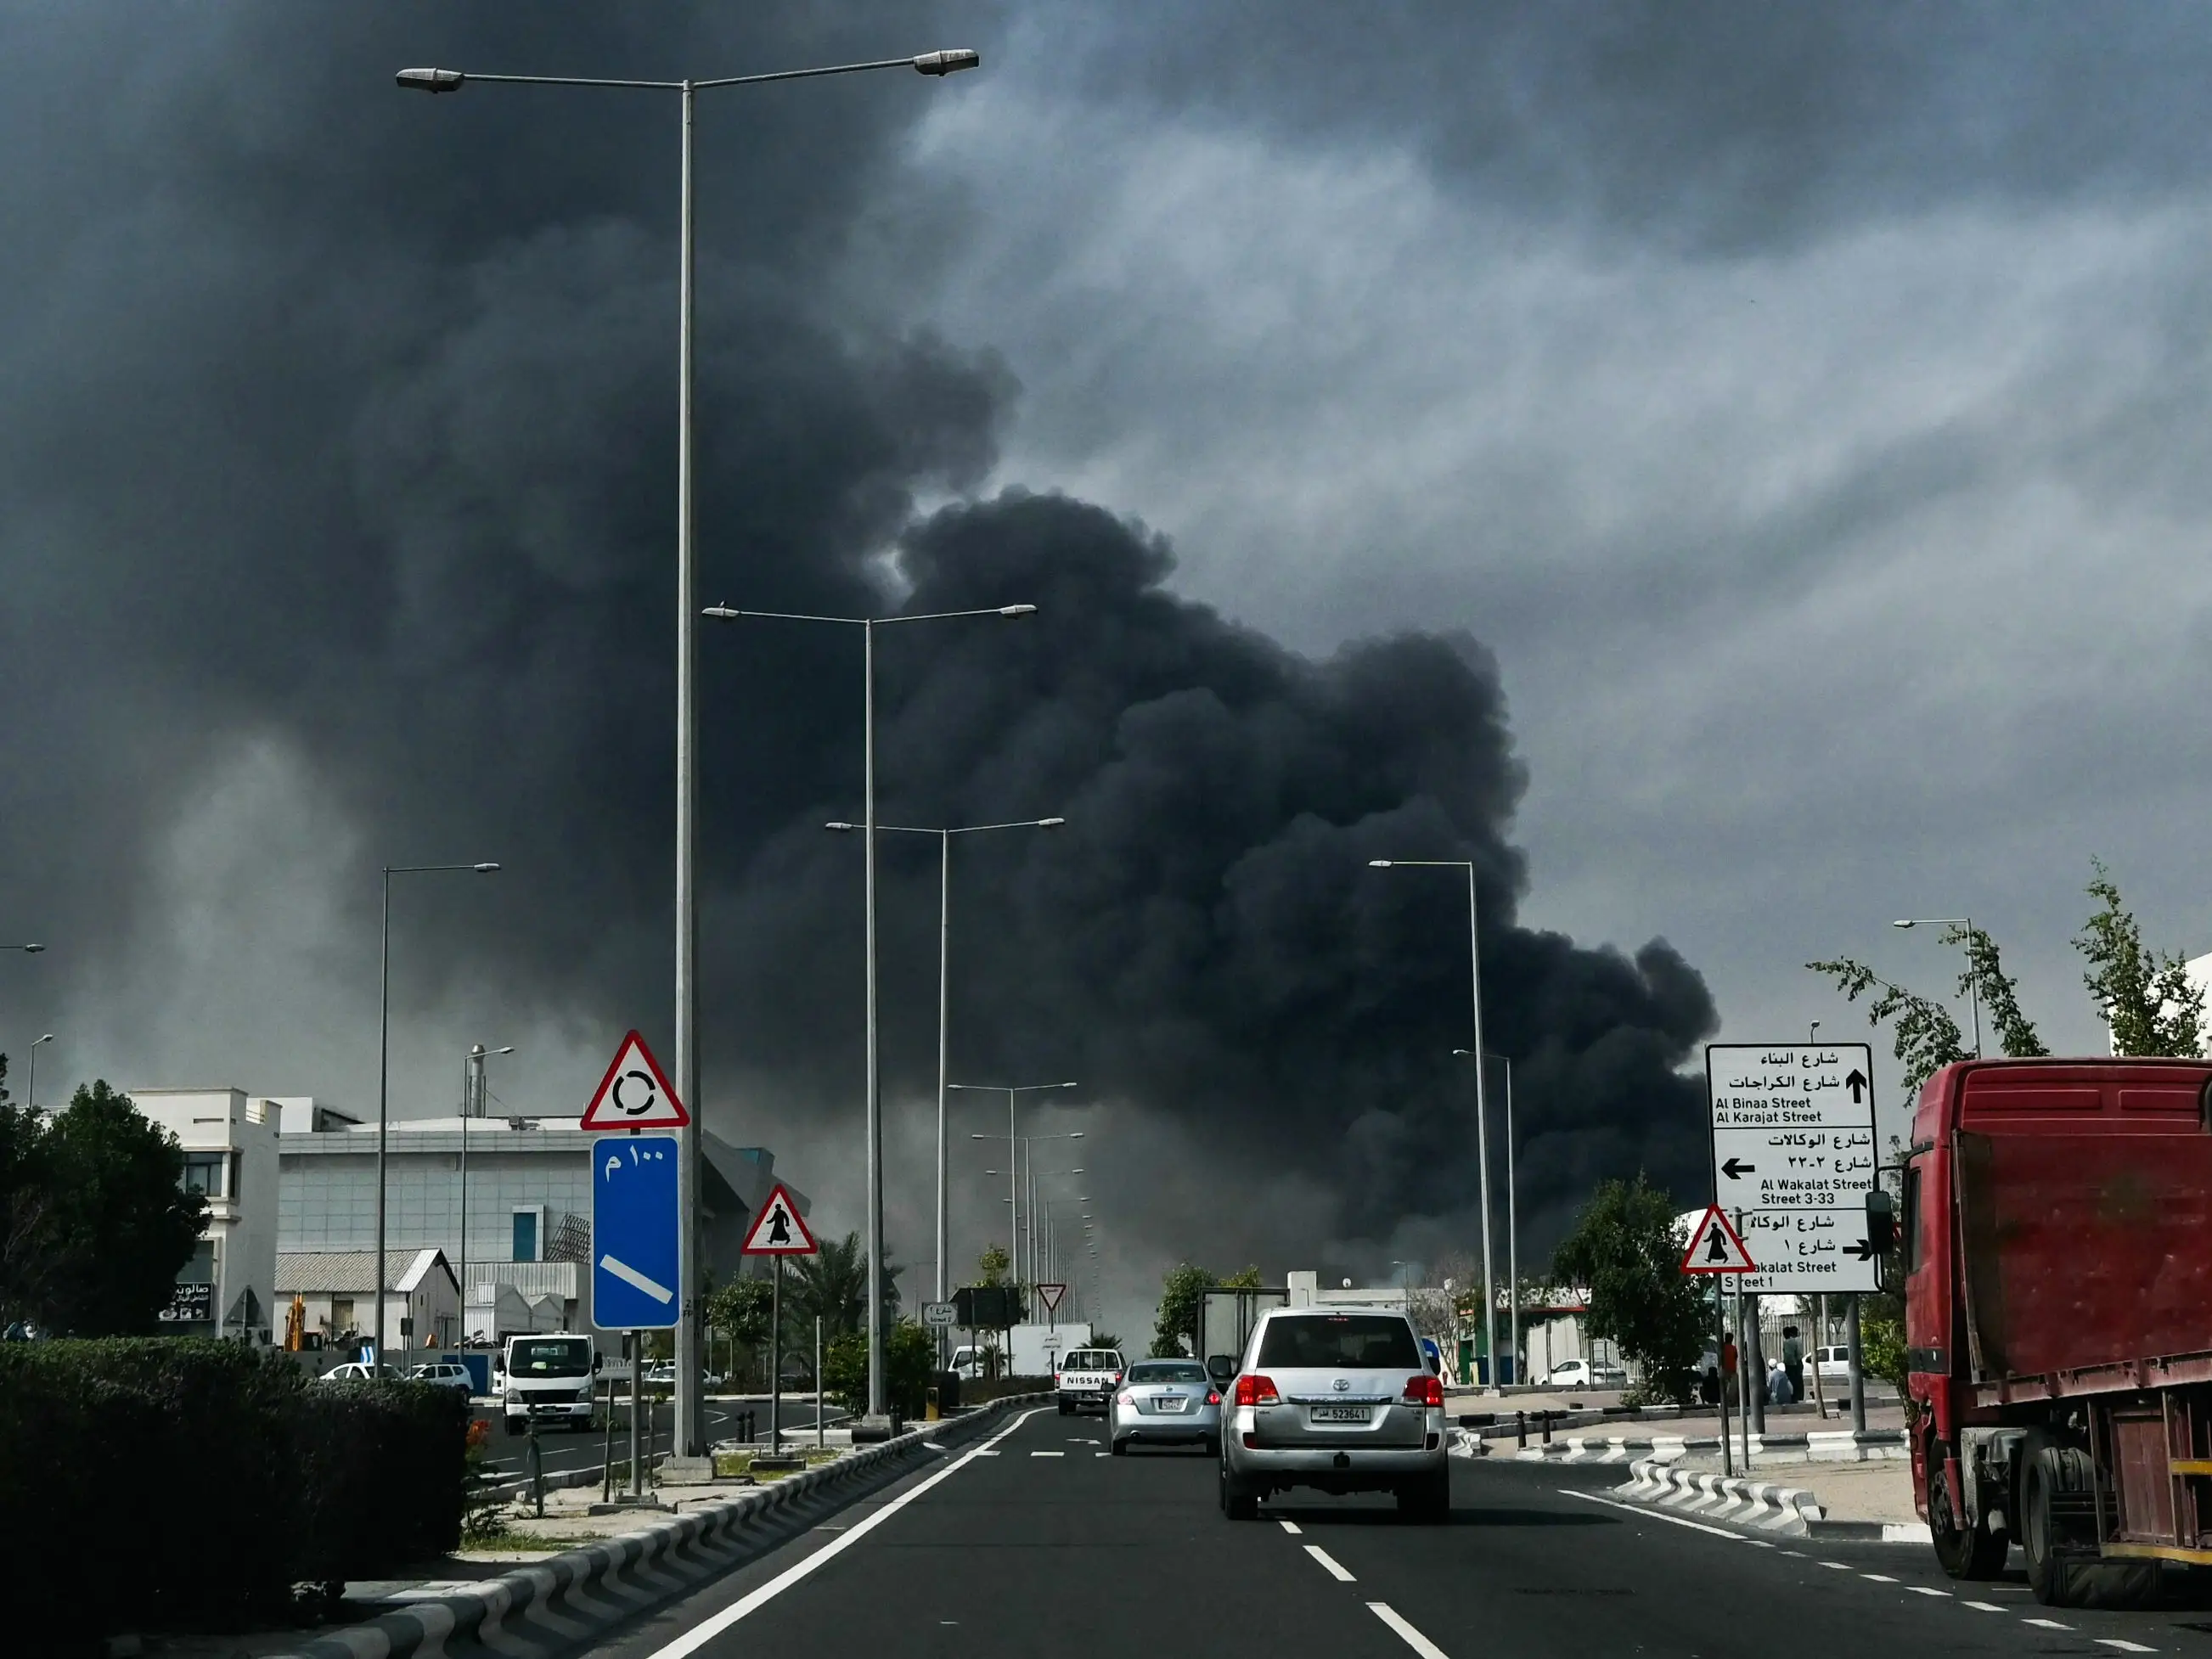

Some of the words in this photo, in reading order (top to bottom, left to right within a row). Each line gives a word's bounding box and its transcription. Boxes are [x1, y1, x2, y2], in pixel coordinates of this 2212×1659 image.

[1761, 1053, 1793, 1066] البناء
[1803, 1053, 1838, 1068] شارع
[1730, 1076, 1794, 1090] الكراجات
[1804, 1076, 1839, 1091] شارع
[1716, 1099, 1728, 1109] Al
[1733, 1098, 1767, 1108] Binaa
[1772, 1098, 1810, 1108] Street
[1717, 1112, 1729, 1122] Al
[1734, 1111, 1778, 1124] Karajat
[1783, 1111, 1821, 1122] Street
[1769, 1134, 1825, 1148] الوكالات
[1834, 1133, 1870, 1150] شارع
[1835, 1157, 1871, 1173] شارع
[1761, 1179, 1774, 1189] Al
[1778, 1179, 1828, 1189] Wakalat
[1833, 1179, 1871, 1189] Street
[1762, 1194, 1800, 1204] Street
[1805, 1193, 1834, 1204] 3-33
[1798, 1216, 1834, 1232] شارع
[1799, 1240, 1835, 1256] شارع
[1798, 1262, 1836, 1272] Street
[1769, 1277, 1772, 1286] 1
[1067, 1376, 1109, 1385] NISSAN
[1332, 1409, 1365, 1419] 523641
